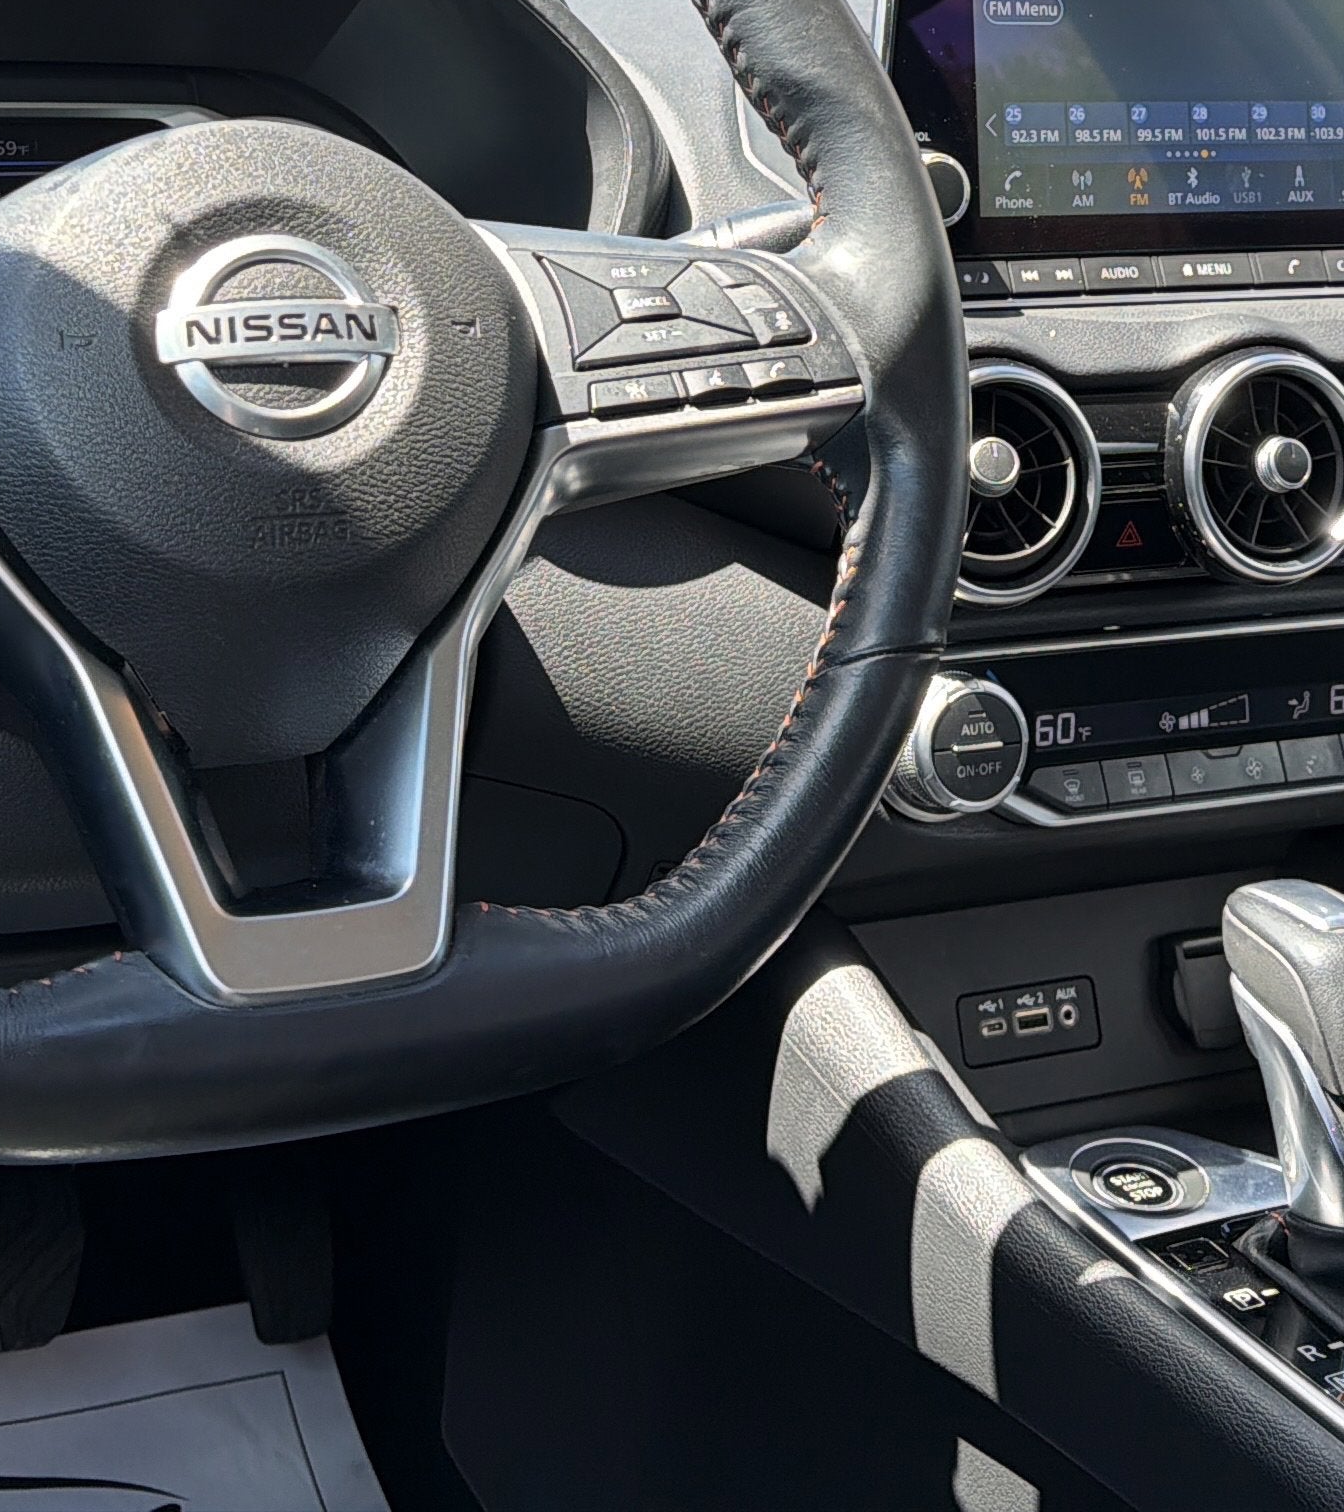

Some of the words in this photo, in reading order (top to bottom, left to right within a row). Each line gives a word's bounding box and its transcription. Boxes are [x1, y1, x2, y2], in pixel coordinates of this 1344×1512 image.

[989, 0, 1011, 17] FM
[1016, 0, 1058, 17] Menu
[1006, 107, 1022, 122] 25
[1069, 107, 1086, 121] 26
[1131, 106, 1147, 121] 27
[1192, 106, 1208, 120] 28
[1252, 106, 1268, 120] 29
[1310, 106, 1326, 120] 30
[1011, 130, 1038, 144] 92.3
[1041, 129, 1060, 143] FM
[1075, 129, 1102, 143] 98.5
[1103, 129, 1122, 142] FM
[1137, 128, 1163, 142] 99.5
[1165, 128, 1183, 141] FM
[1196, 128, 1226, 140] 101.5
[1228, 127, 1247, 140] FM
[1255, 128, 1286, 140] 102.3
[1288, 127, 1306, 140] FM
[1314, 127, 1344, 140] 103.9
[995, 196, 1034, 209] Phone
[1072, 194, 1094, 207] AM
[1129, 193, 1149, 206] FM
[1168, 192, 1184, 205] BT
[1186, 192, 1221, 205] Audio
[1233, 190, 1262, 204] USB1
[1287, 190, 1314, 203] AUX
[1100, 266, 1139, 280] AUDIO
[1196, 262, 1233, 276] MENU
[185, 312, 378, 348] NISSAN
[960, 720, 995, 736] AUTO
[1056, 986, 1077, 1000] AUX
[1129, 1186, 1164, 1201] STOP
[1297, 1345, 1327, 1363] R
